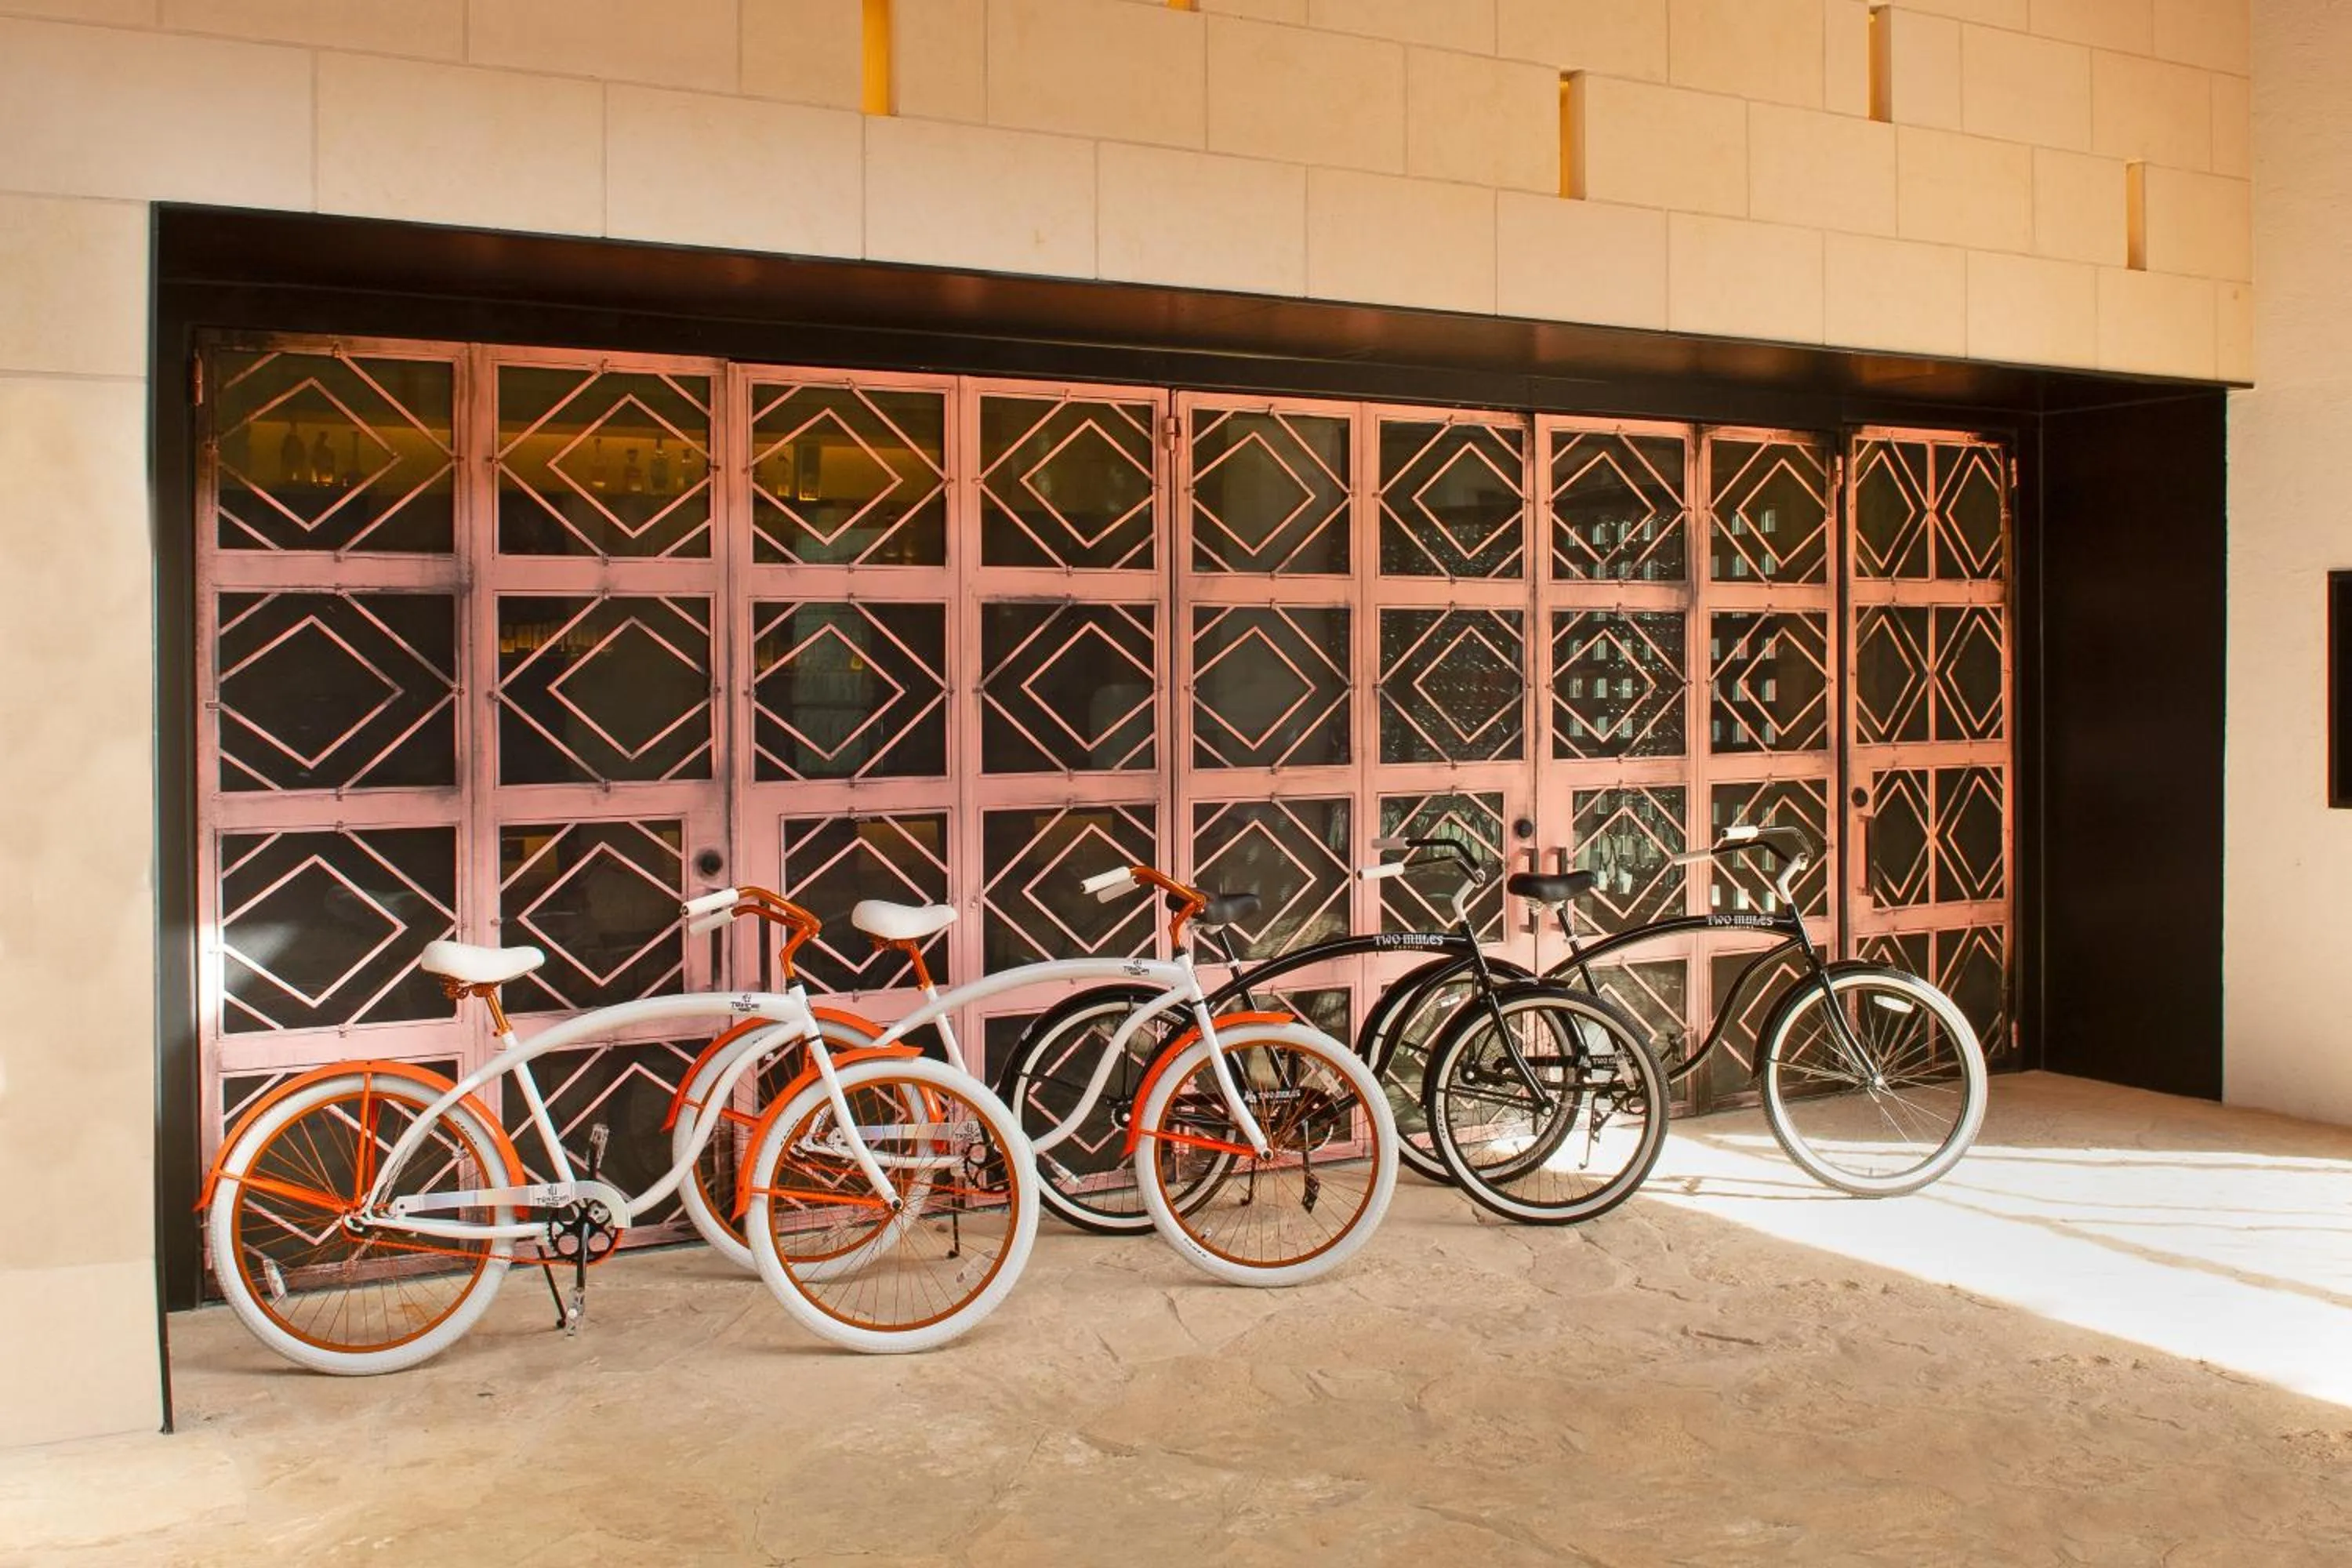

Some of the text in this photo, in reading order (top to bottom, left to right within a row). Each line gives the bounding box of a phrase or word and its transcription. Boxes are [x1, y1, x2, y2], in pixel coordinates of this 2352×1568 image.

[1706, 914, 1774, 926] TWO MULES
[1374, 934, 1443, 946] TWO MULES
